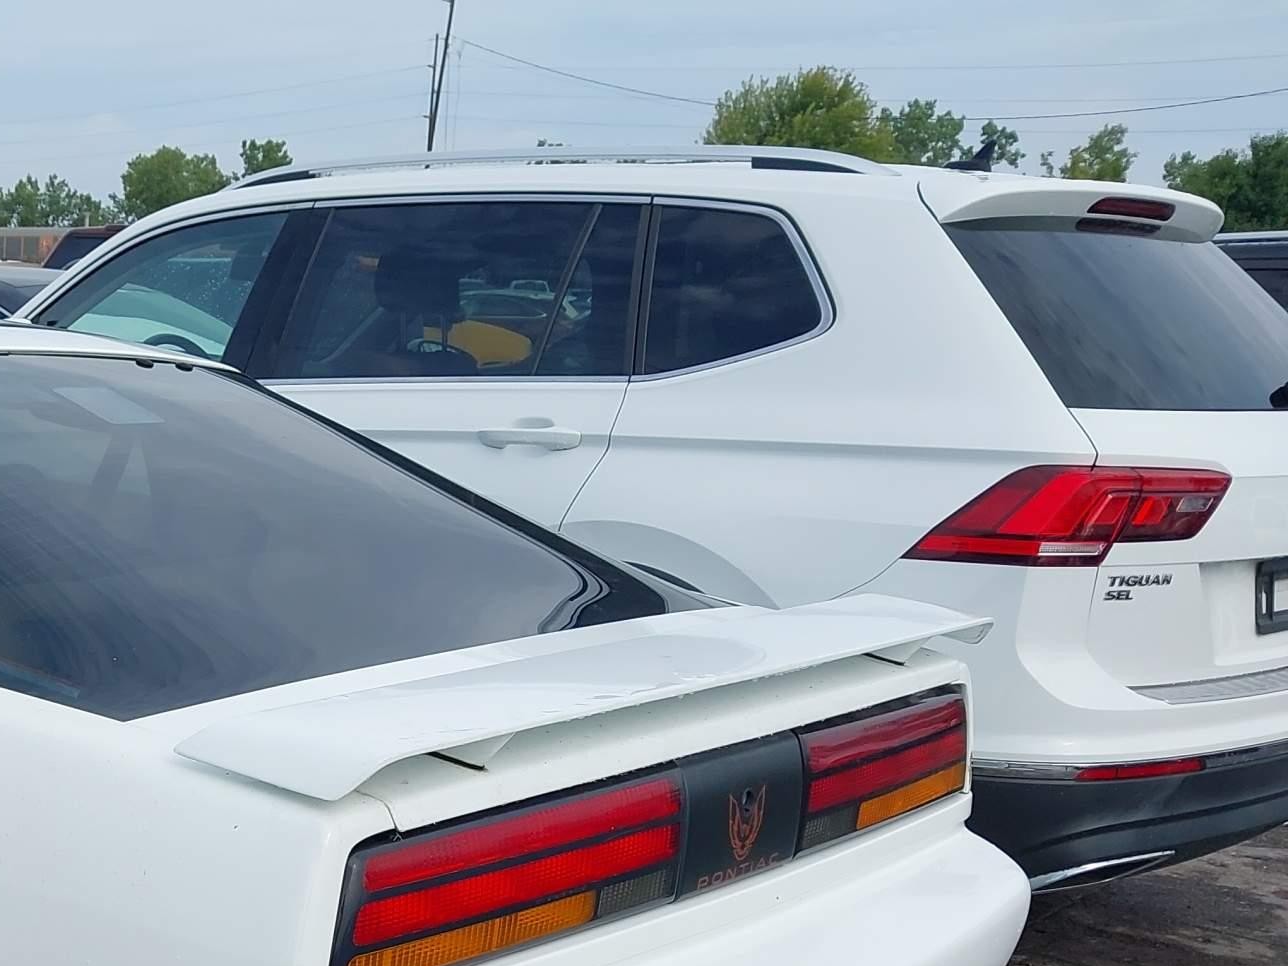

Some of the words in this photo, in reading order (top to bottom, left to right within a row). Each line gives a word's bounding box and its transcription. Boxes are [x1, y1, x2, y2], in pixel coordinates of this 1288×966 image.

[1108, 574, 1173, 587] TIGUAN
[1103, 589, 1134, 601] SEL
[697, 852, 779, 889] PONTIAC
